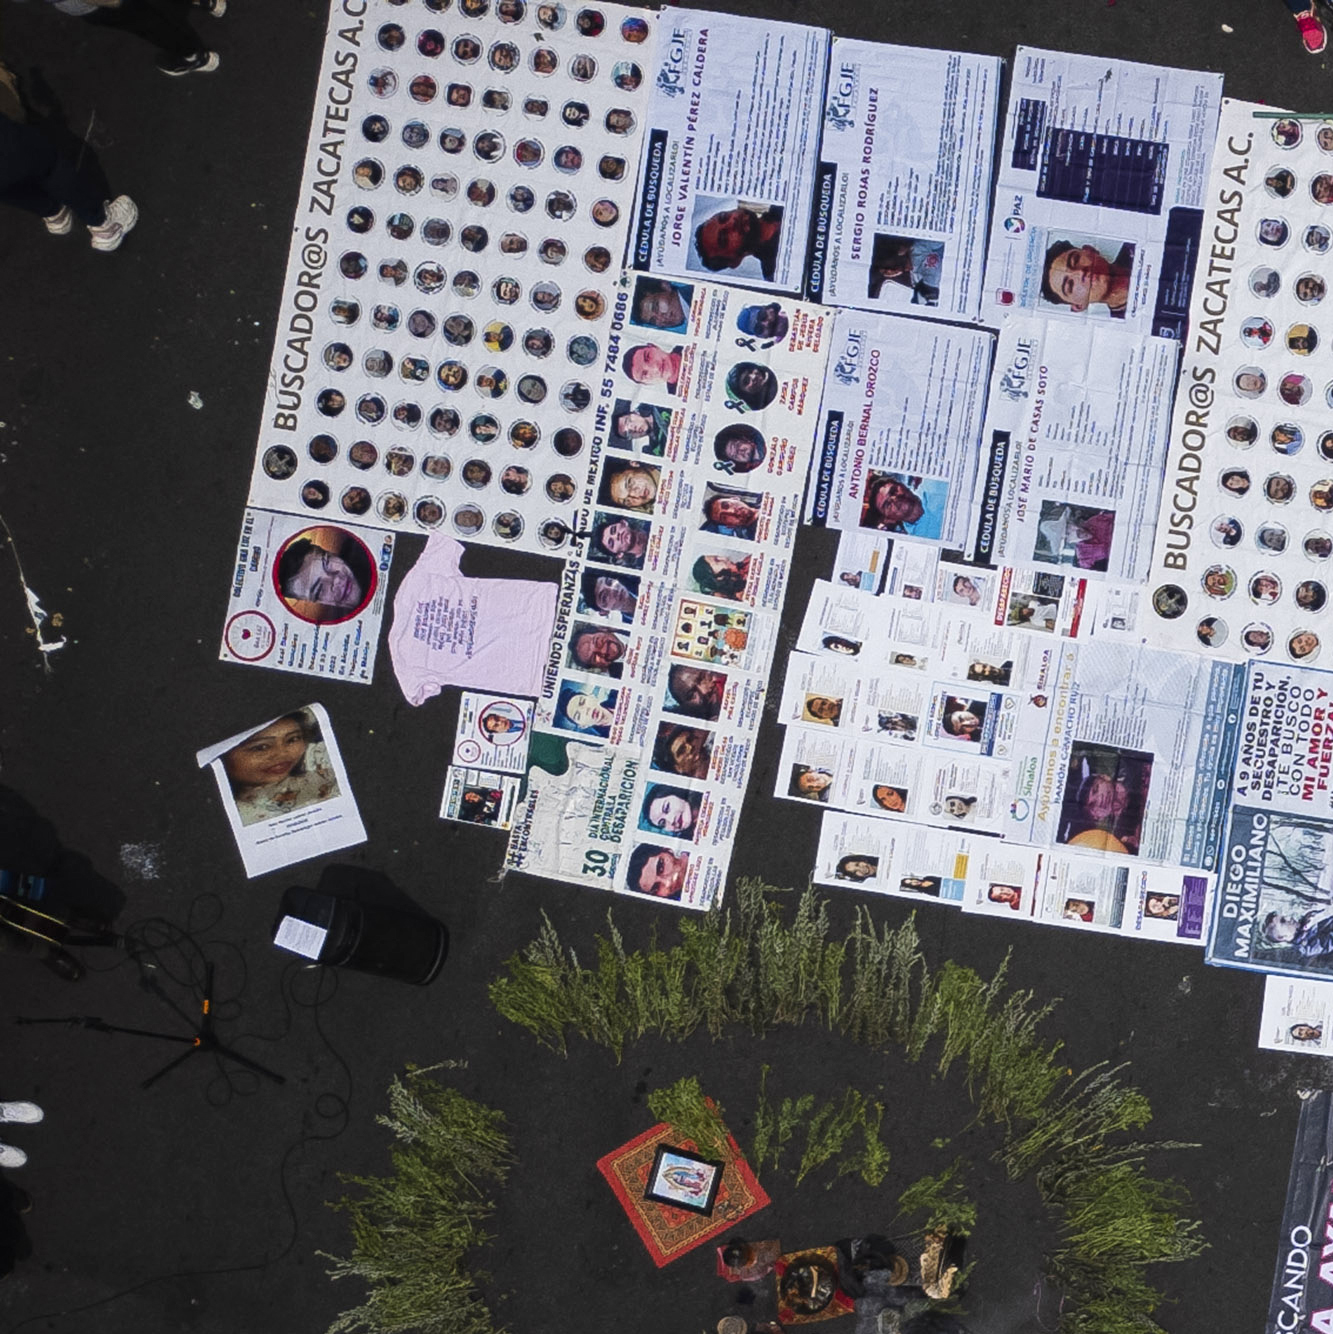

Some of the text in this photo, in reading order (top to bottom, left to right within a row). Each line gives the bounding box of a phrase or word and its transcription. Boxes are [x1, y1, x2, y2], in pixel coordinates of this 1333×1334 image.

[666, 27, 686, 74] FGJE
[669, 27, 709, 246] JORGE VALENTÍN PÉREZ CALDERA
[849, 86, 880, 260] SERGIO ROJAS RODRÍGUEZ
[638, 140, 663, 262] CÉDULA DE BÚSQUEDA
[273, 225, 329, 431] BUSCADOR@S
[308, 49, 358, 215] ZACATECAS
[611, 292, 628, 331] 0686
[600, 378, 613, 397] 55
[604, 334, 620, 372] 7484
[1011, 336, 1032, 379] FGJE
[1163, 365, 1217, 571] BUSCADOR@S
[1198, 187, 1244, 354] ZACATECAS
[1223, 129, 1253, 184] A.C.
[595, 403, 609, 432] INF.
[848, 349, 881, 499] ANTONIO BERNAL OROZCO
[1014, 365, 1049, 522] JOSÉ MARIO DE CASAS SOTO
[569, 509, 589, 557] ESADO
[979, 440, 1006, 552] CÉDULA DE BÚSQUEDA
[554, 559, 580, 639] ESPERANZAS
[543, 641, 564, 698] UNIENDO
[1247, 695, 1261, 716] DE
[1251, 671, 1265, 692] TU
[1241, 720, 1258, 766] AÑOS
[1250, 681, 1276, 790] SECUESTRO Y
[1260, 674, 1291, 801] DESAPARICIÓN,
[1281, 685, 1302, 755] BUSCO
[1289, 688, 1314, 796] CON TODO
[1302, 687, 1328, 801] MI AMOR Y
[1239, 769, 1251, 780] 9
[581, 848, 610, 878] 30
[1223, 843, 1247, 918] DIEGO
[1234, 812, 1268, 957] MAXIMILIANO
